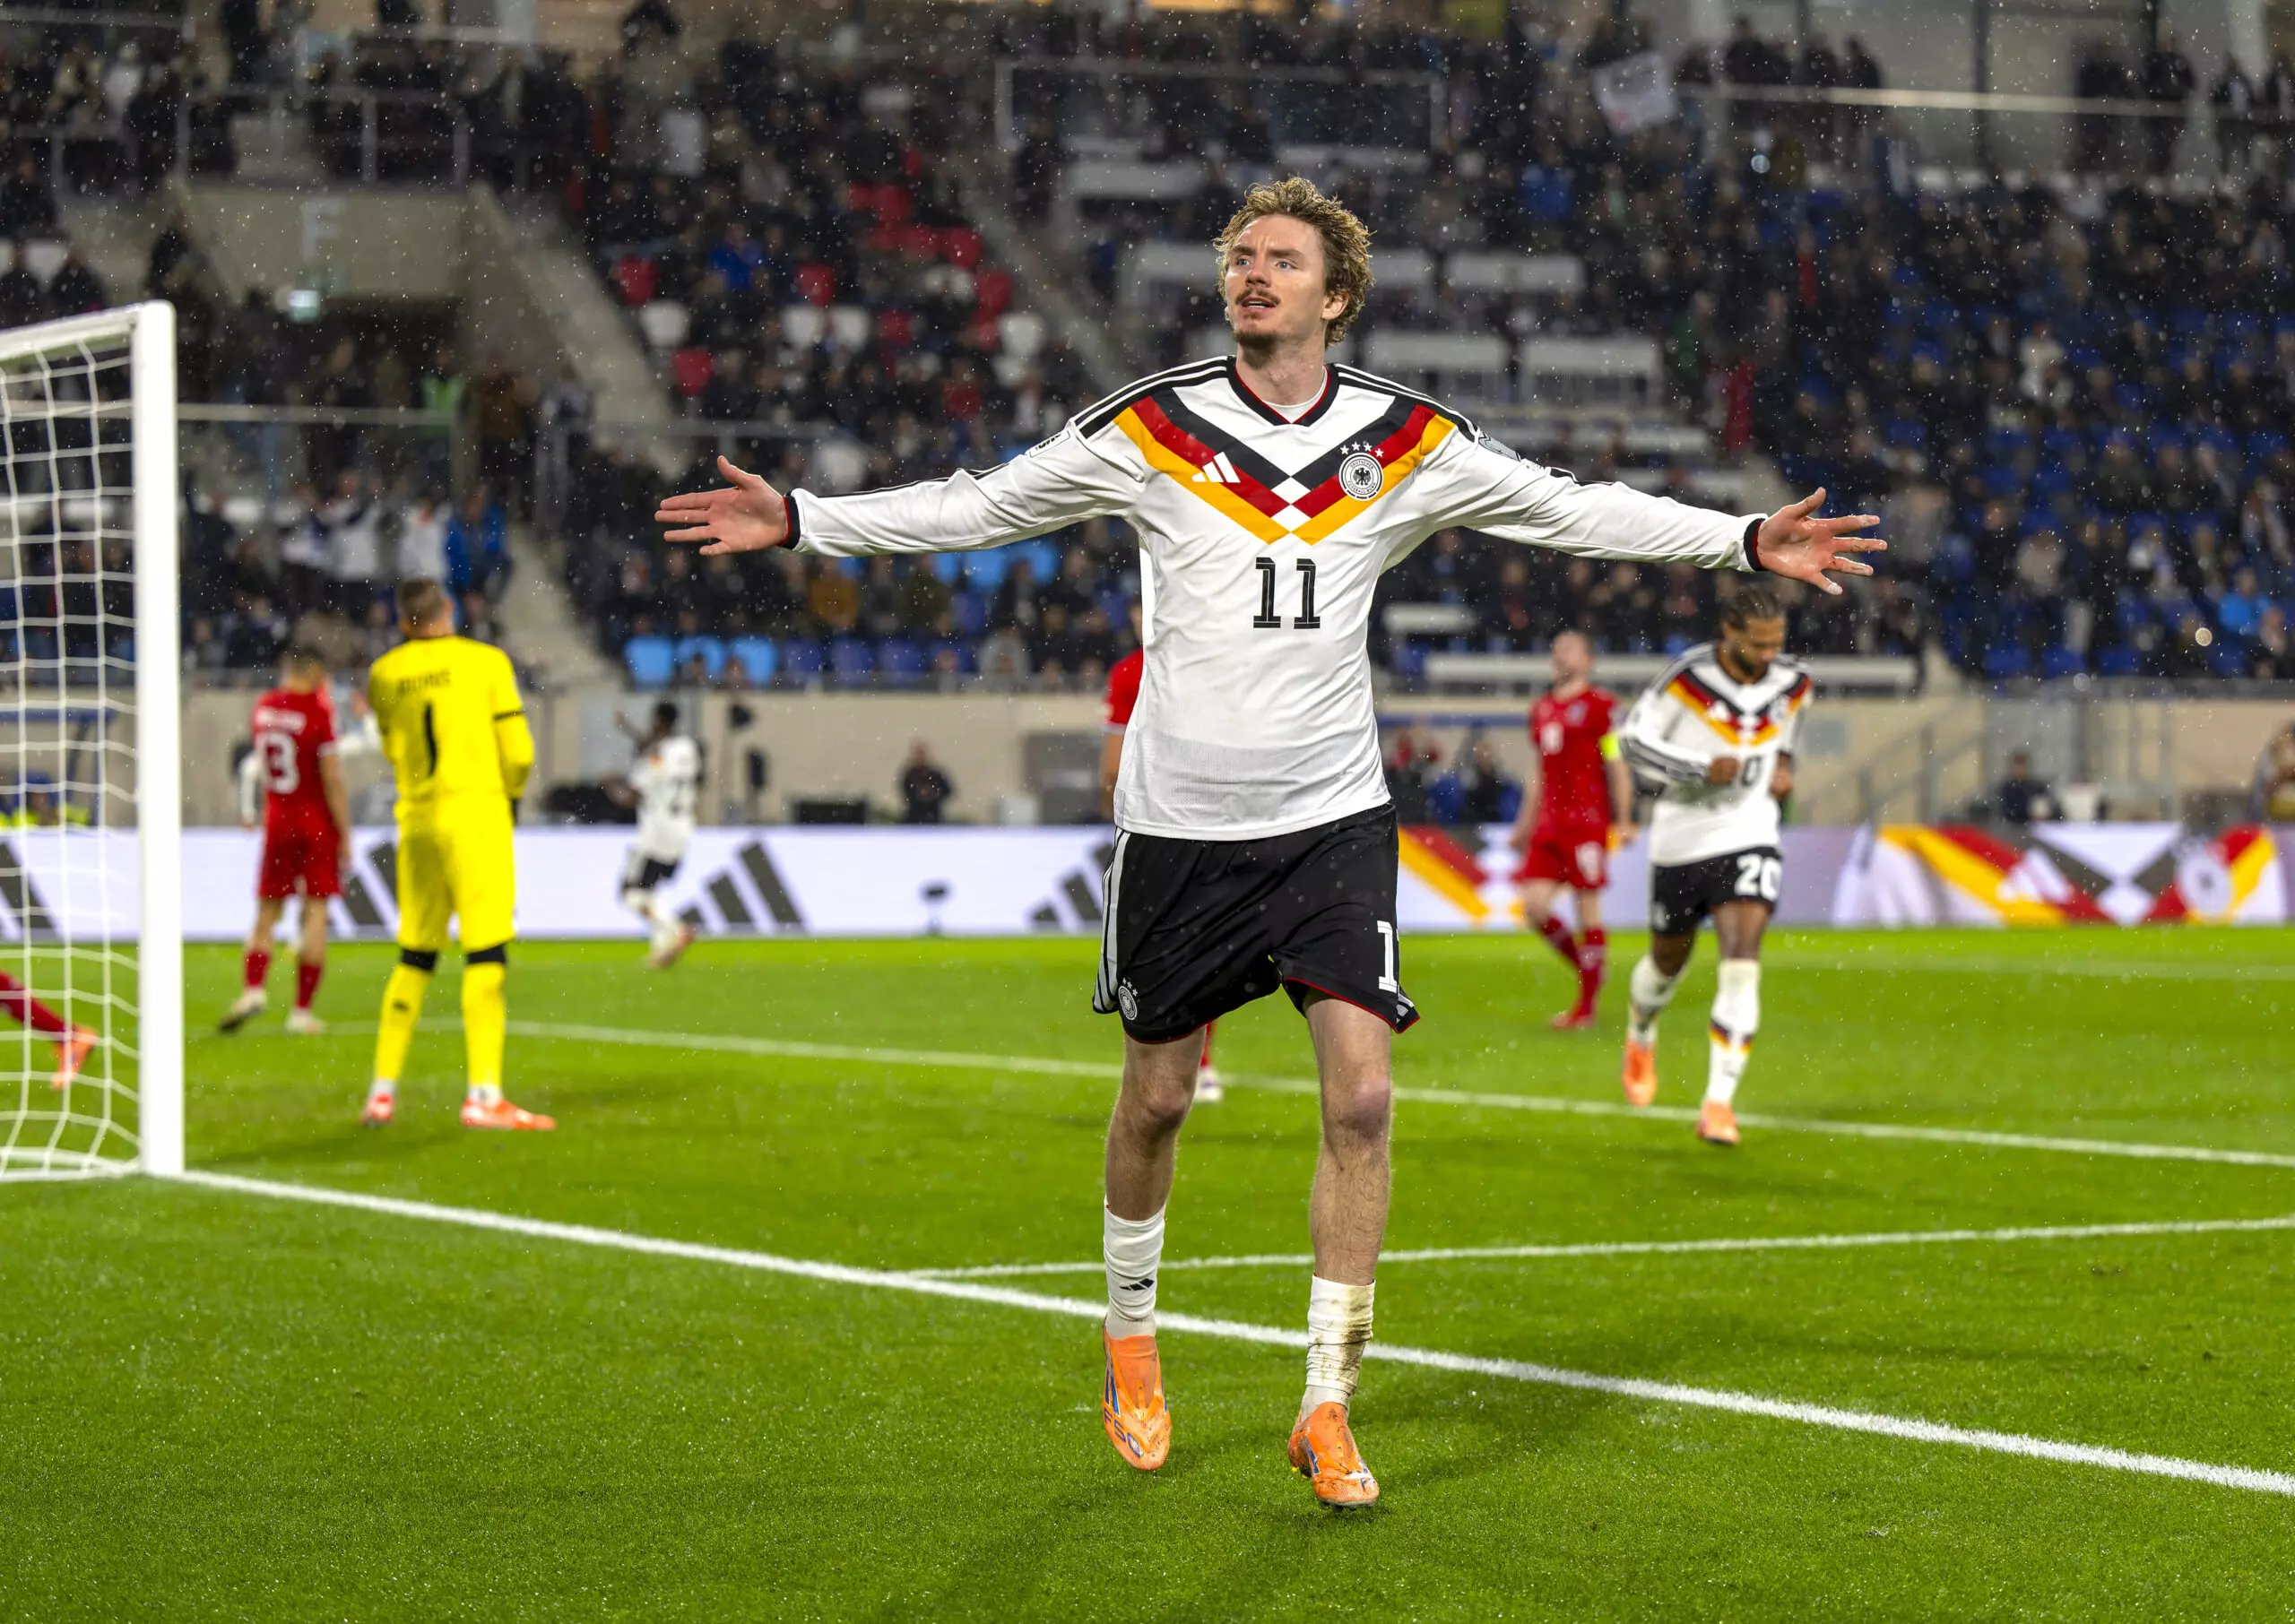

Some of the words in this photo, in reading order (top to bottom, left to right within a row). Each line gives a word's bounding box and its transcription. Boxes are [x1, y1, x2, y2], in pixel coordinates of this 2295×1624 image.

[1350, 460, 1374, 470] DEUTSCHER
[1252, 557, 1321, 629] 11
[1734, 853, 1781, 901] 20
[1104, 1406, 1144, 1458] F50
